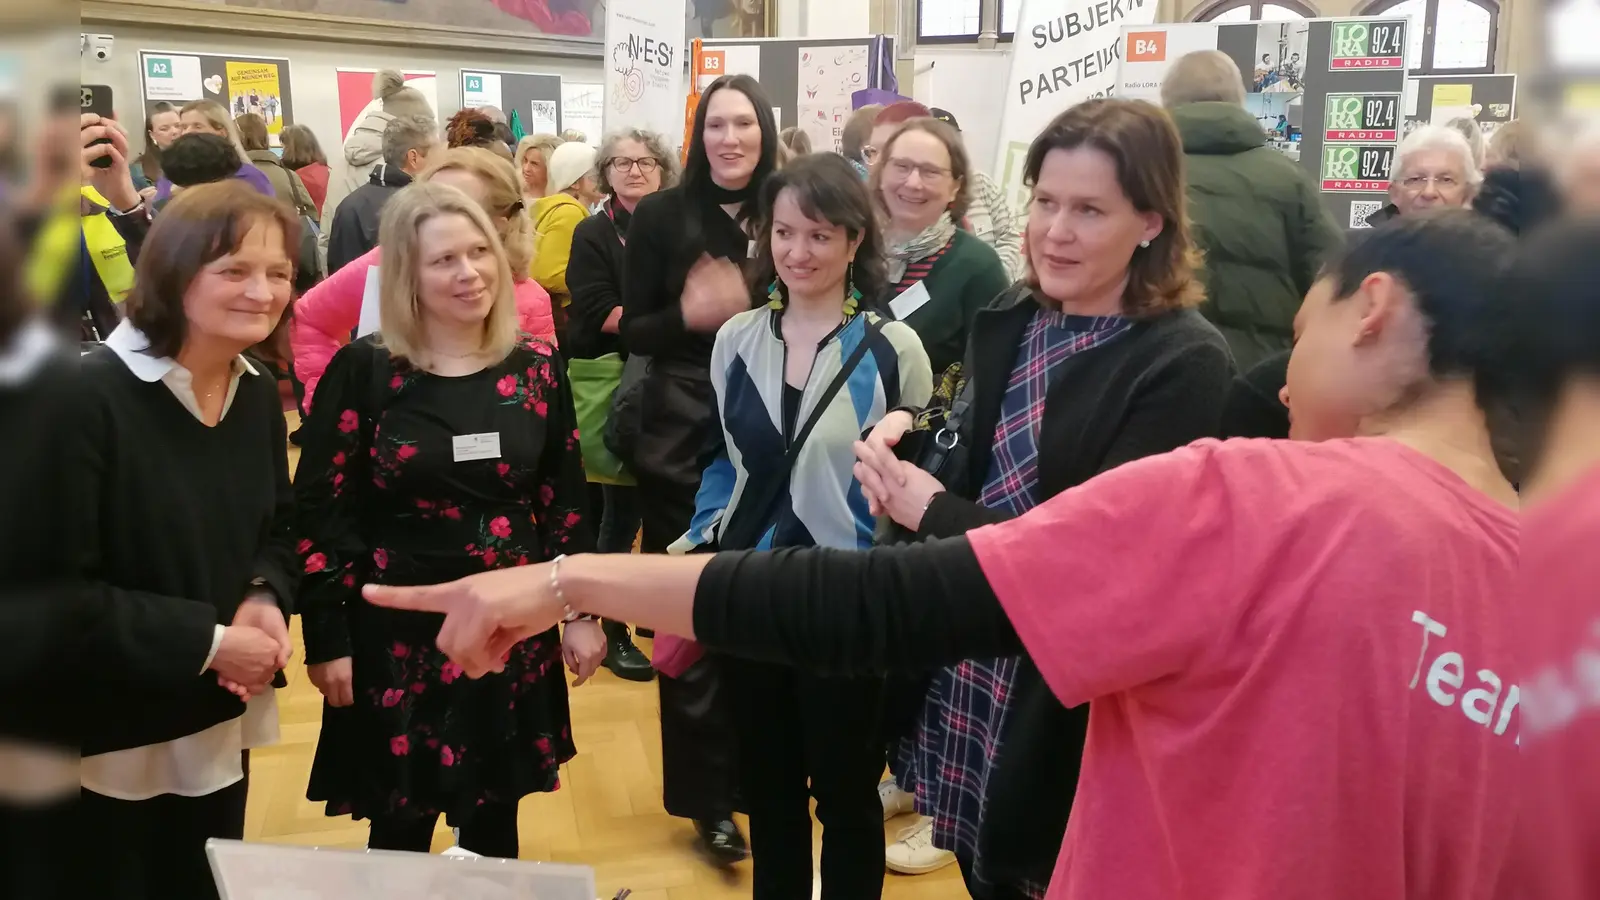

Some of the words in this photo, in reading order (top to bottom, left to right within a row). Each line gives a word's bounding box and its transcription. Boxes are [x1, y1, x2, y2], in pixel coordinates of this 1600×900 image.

[1135, 39, 1157, 55] B4
[1372, 26, 1400, 54] 92.4
[153, 63, 167, 73] A2
[704, 57, 719, 69] B3
[469, 79, 480, 89] A3
[1366, 100, 1394, 126] 92.4
[1362, 150, 1390, 177] 92.4
